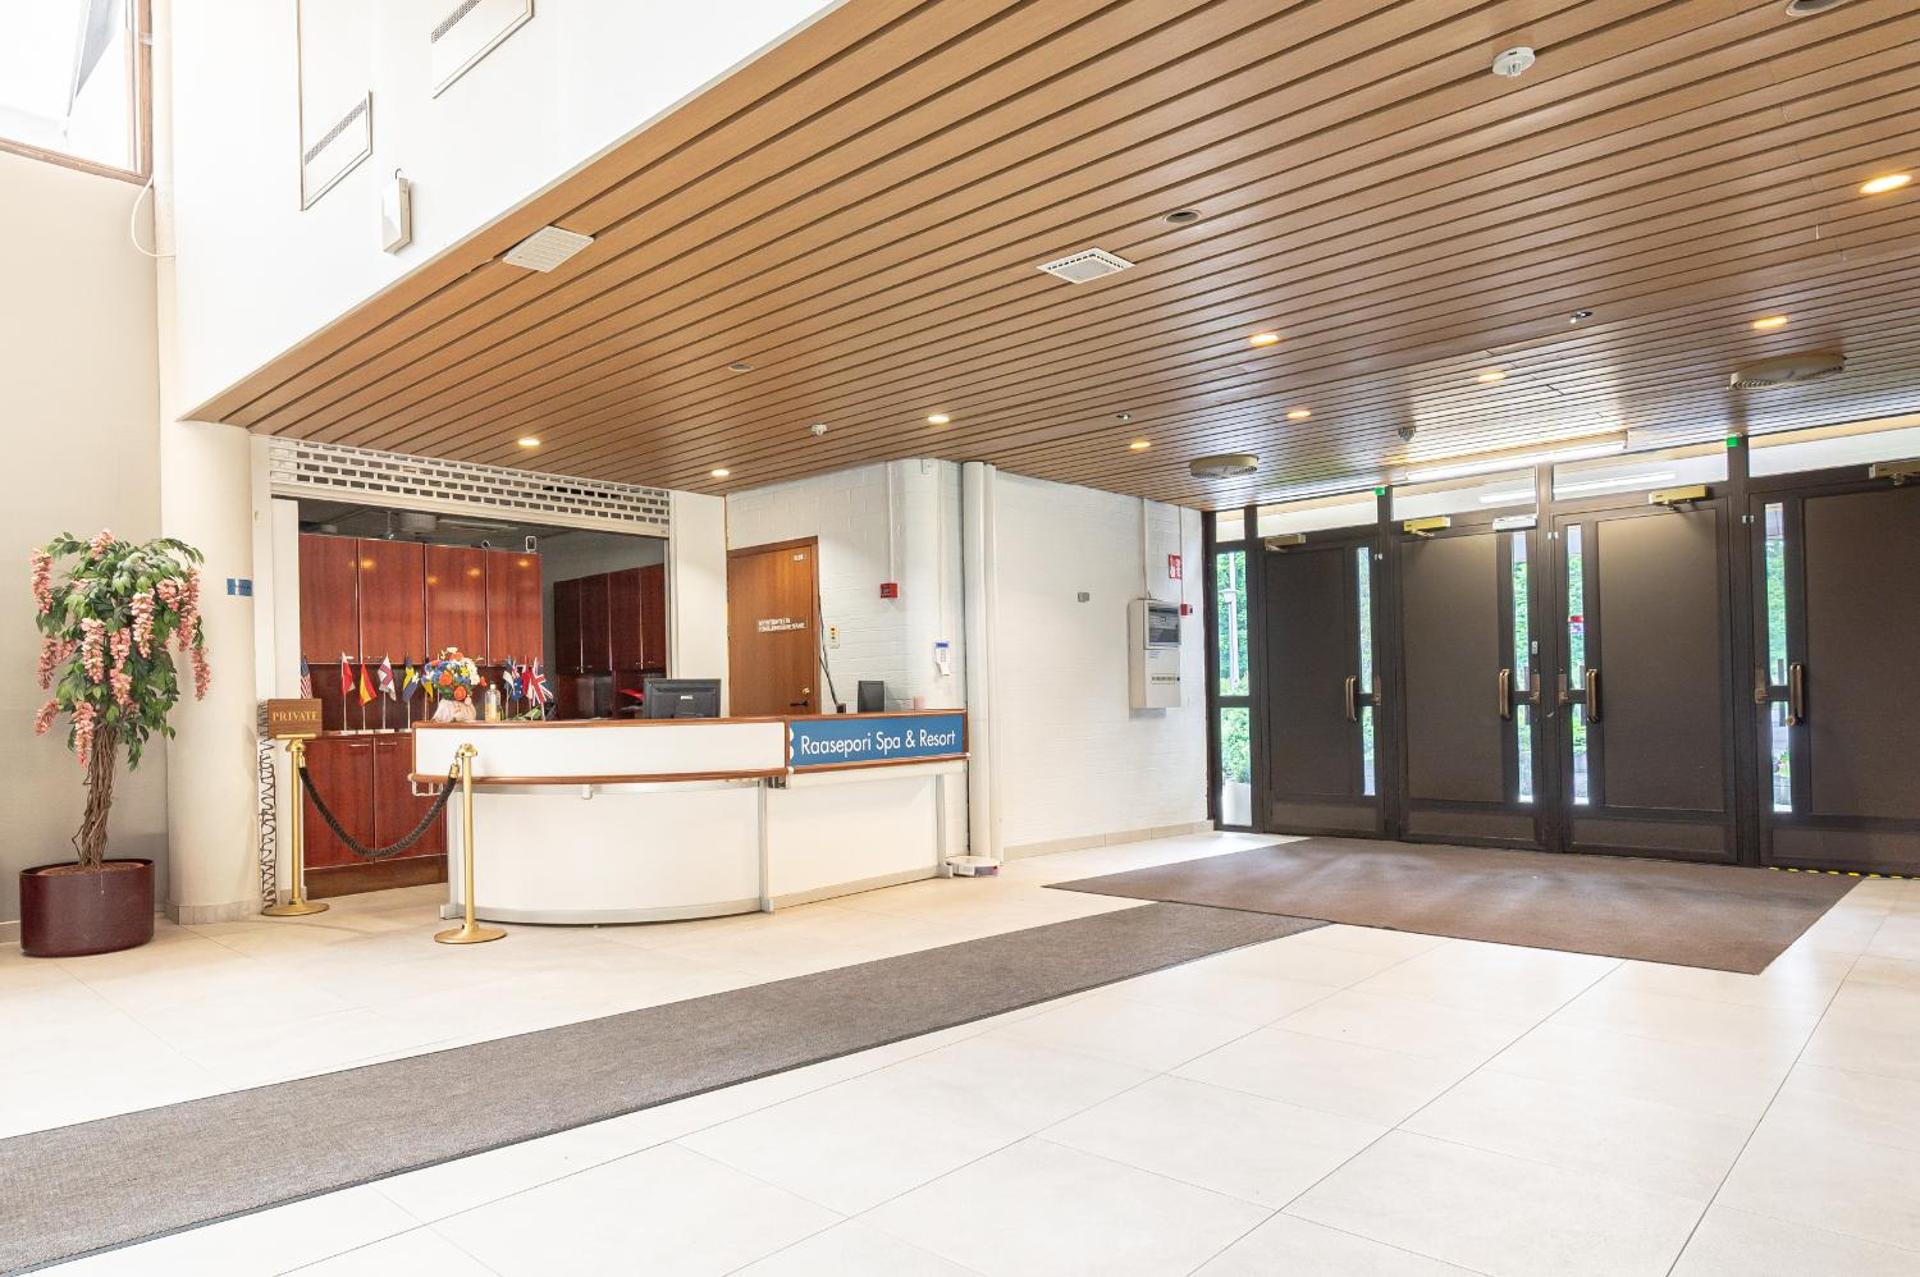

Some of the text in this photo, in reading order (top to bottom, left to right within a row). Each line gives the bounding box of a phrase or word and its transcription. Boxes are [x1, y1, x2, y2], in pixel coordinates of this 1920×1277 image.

[272, 711, 318, 721] PRIVATE
[801, 729, 956, 758] Raasepori Spa & Resort
